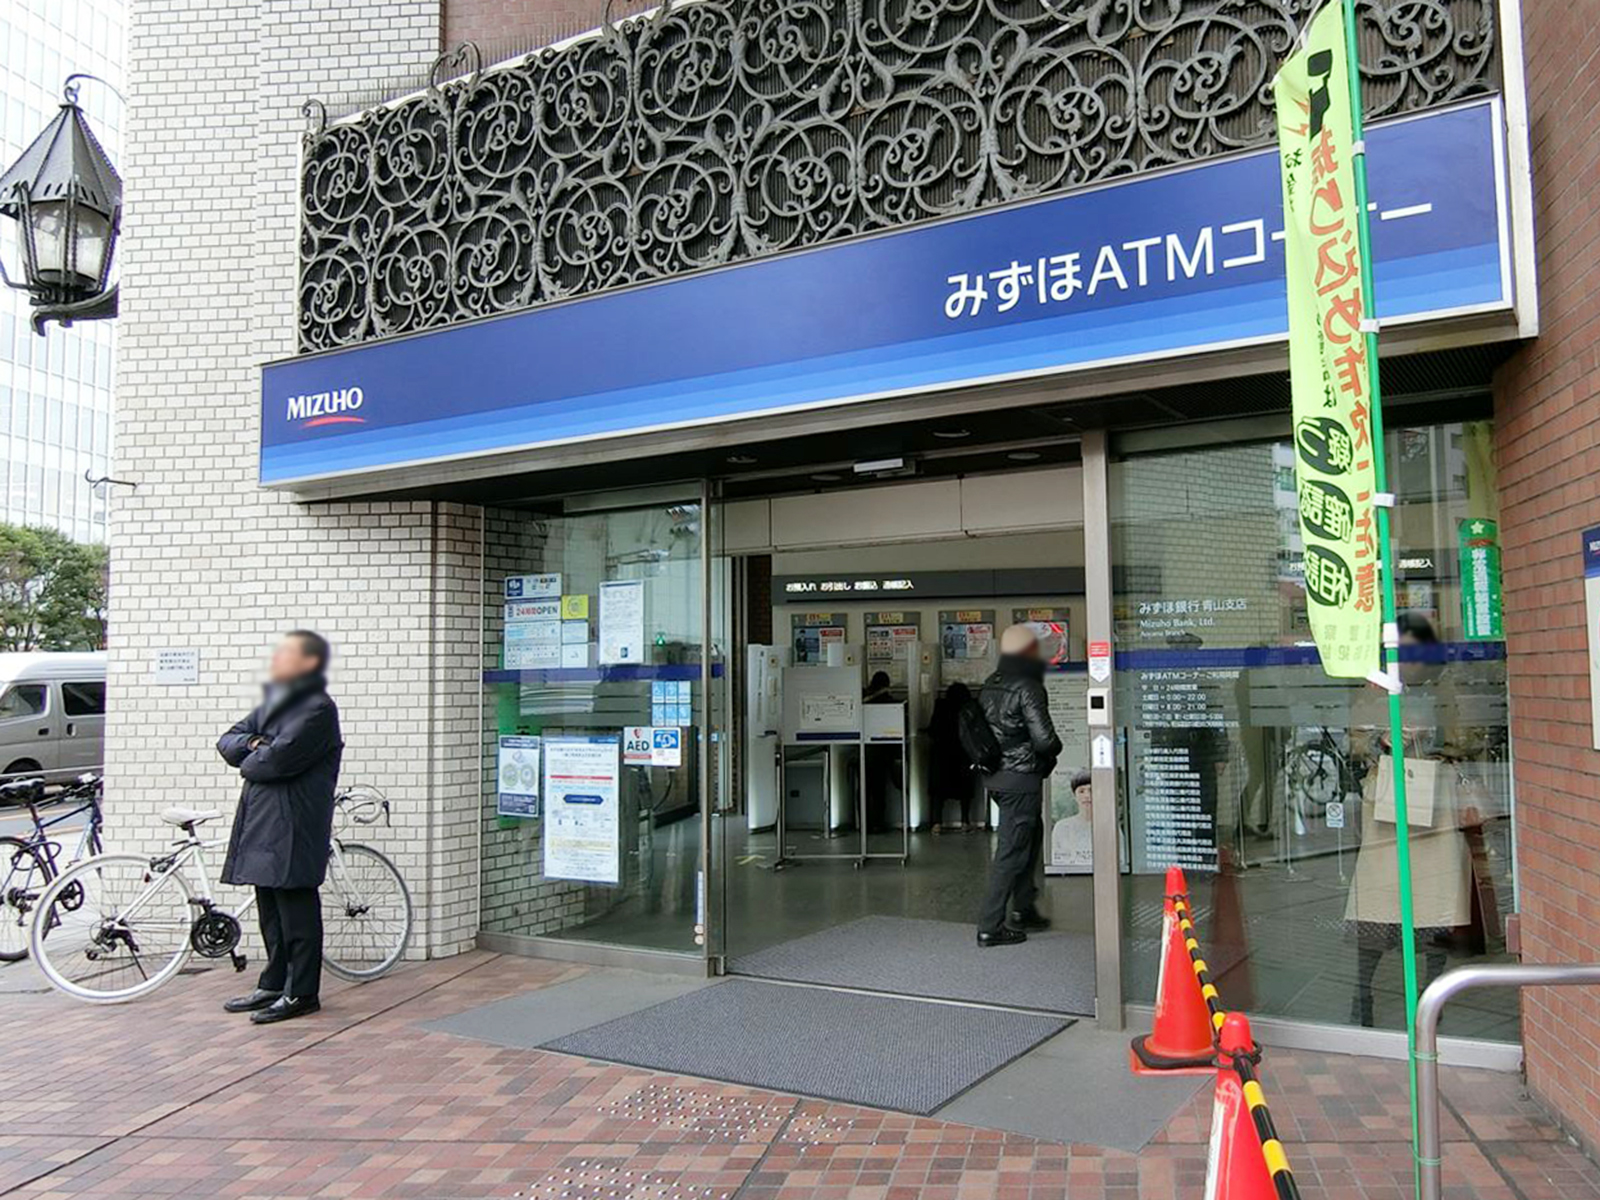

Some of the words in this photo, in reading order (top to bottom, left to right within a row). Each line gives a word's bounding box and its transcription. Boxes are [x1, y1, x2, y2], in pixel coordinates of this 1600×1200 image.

[945, 203, 1432, 319] みずほATMコー
[286, 387, 363, 421] MIZUHO
[1139, 600, 1199, 614] みずほ銀行
[1140, 619, 1171, 629] Mizuho
[1199, 617, 1215, 627] Ltd.
[626, 741, 650, 752] AED
